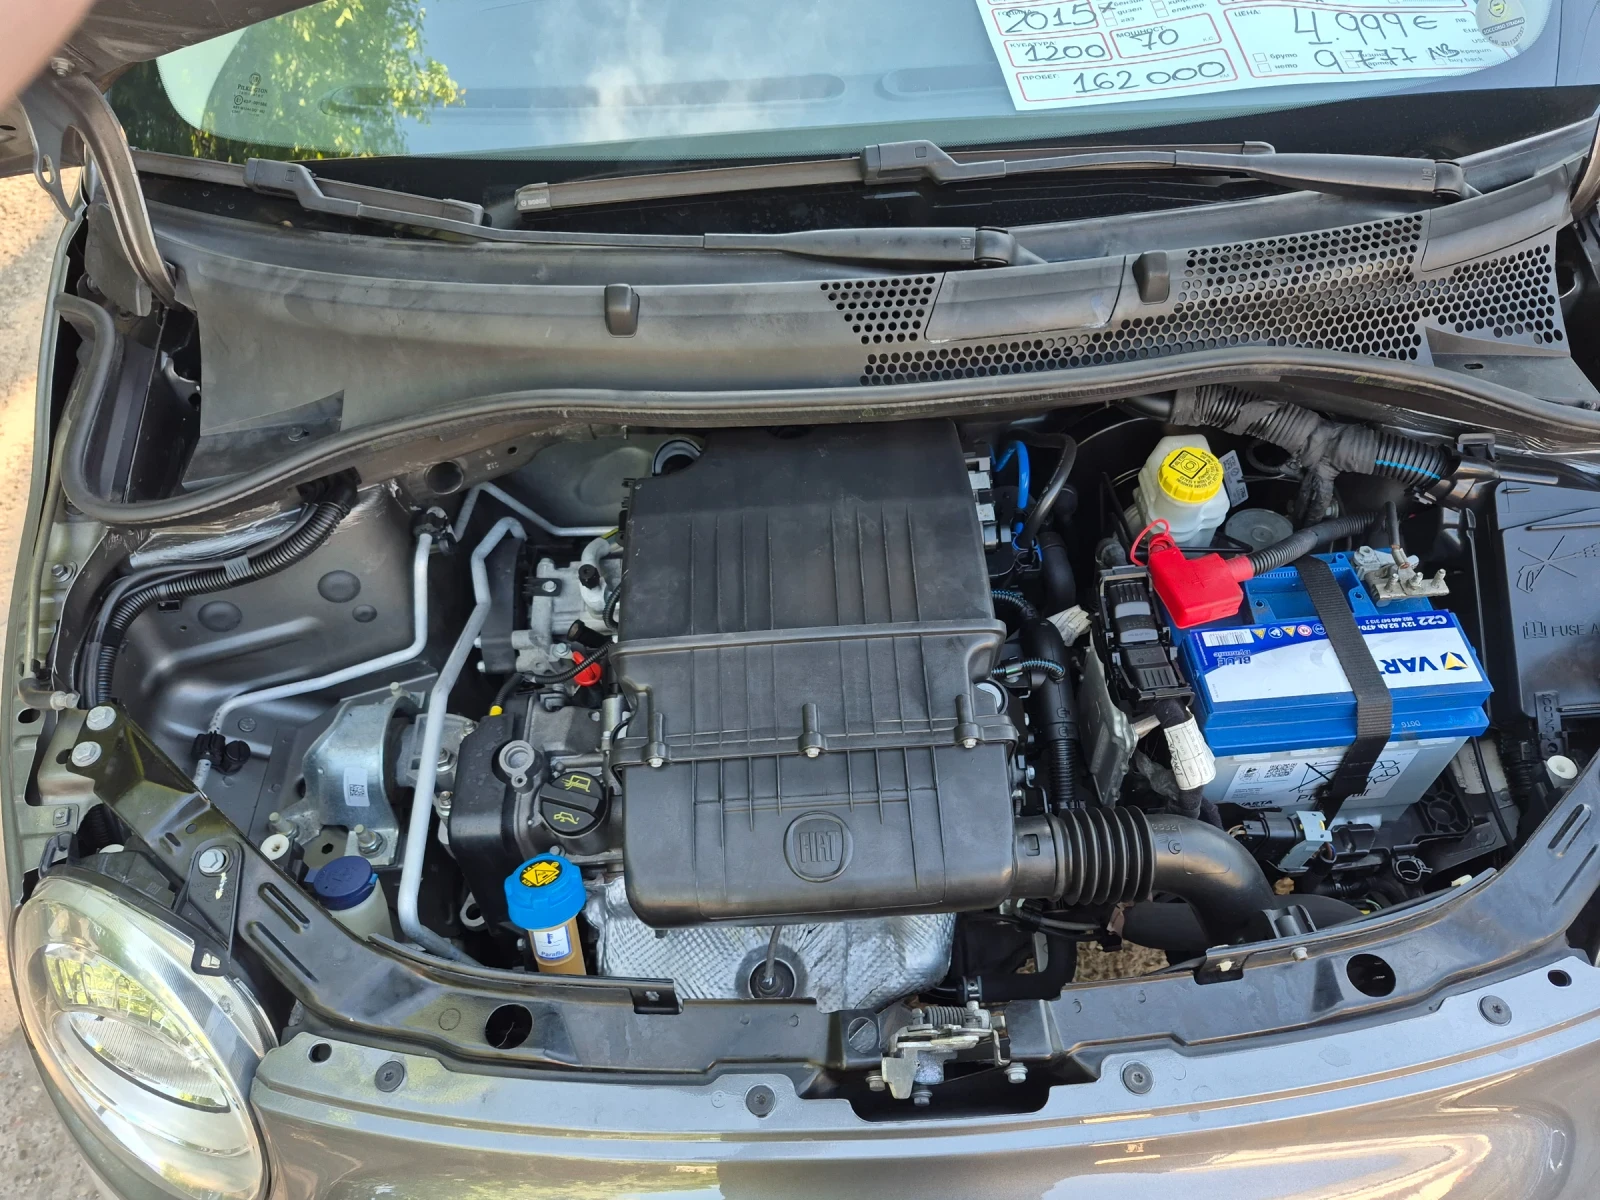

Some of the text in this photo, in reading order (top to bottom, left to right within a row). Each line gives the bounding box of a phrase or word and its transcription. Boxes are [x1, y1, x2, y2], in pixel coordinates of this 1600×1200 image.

[1005, 2, 1097, 33] 2015
[1293, 8, 1408, 45] 4.999
[1129, 28, 1179, 50] 70
[1024, 44, 1106, 62] 1200
[1073, 61, 1225, 93] 162 000
[1417, 615, 1447, 626] C22
[1551, 623, 1586, 637] FUSE
[1217, 656, 1251, 667] BLUE
[1380, 656, 1438, 675] VAR
[799, 831, 839, 863] FIAT
